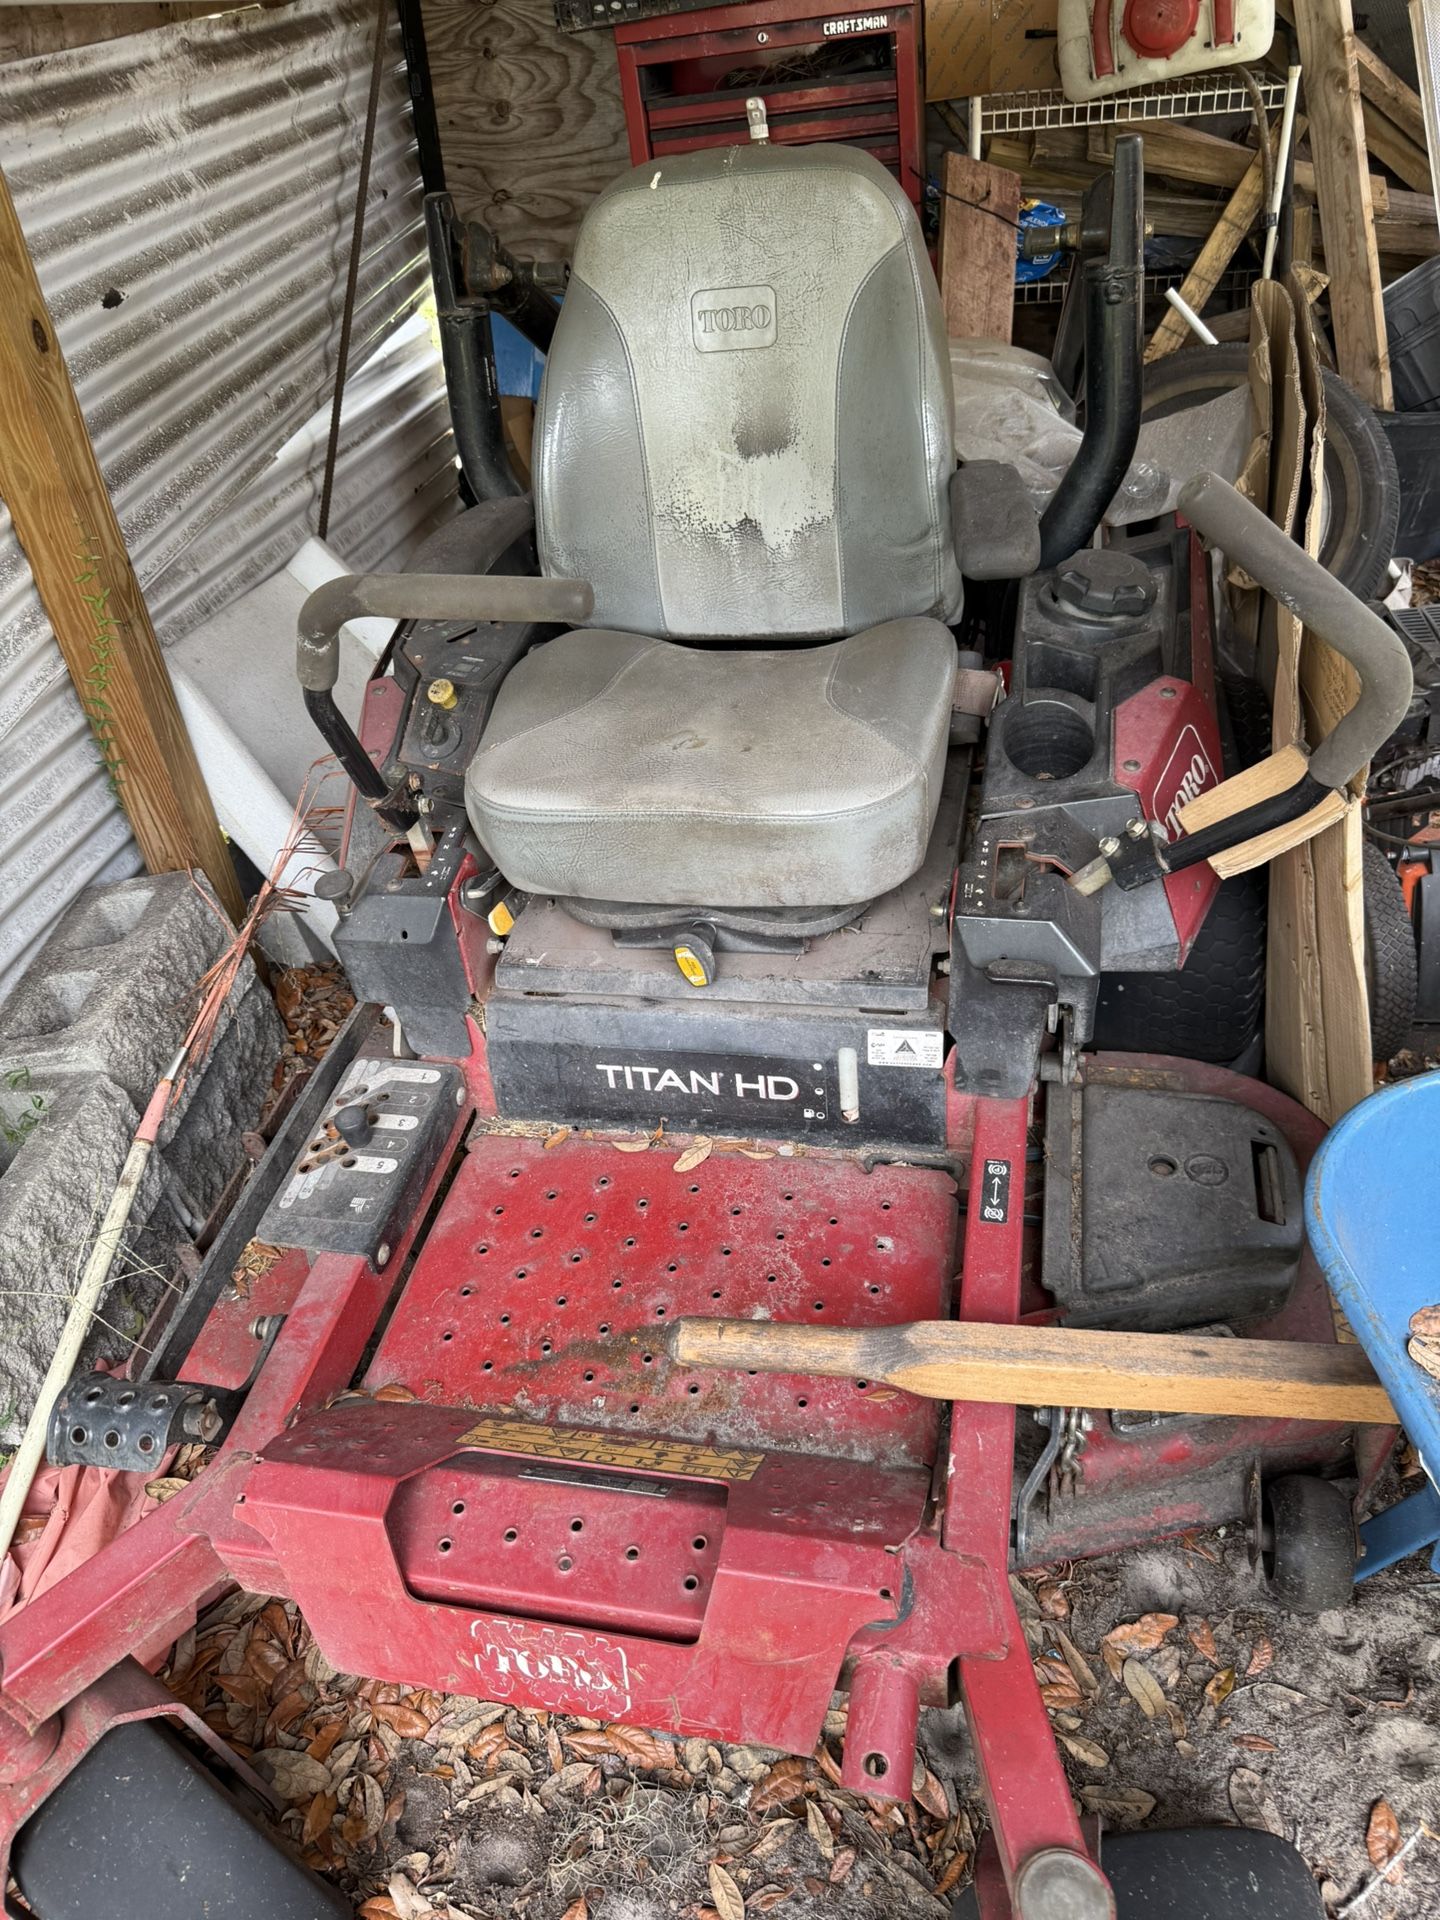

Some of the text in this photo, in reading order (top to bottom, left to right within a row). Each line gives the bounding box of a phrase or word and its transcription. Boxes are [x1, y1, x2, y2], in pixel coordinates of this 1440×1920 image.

[823, 15, 888, 36] CRAFTSMAN
[698, 304, 772, 334] TORO
[595, 1064, 799, 1101] TITAN HD
[408, 1095, 418, 1104] 2
[398, 1118, 406, 1127] 3
[387, 1140, 396, 1149] 4
[376, 1161, 385, 1169] 5
